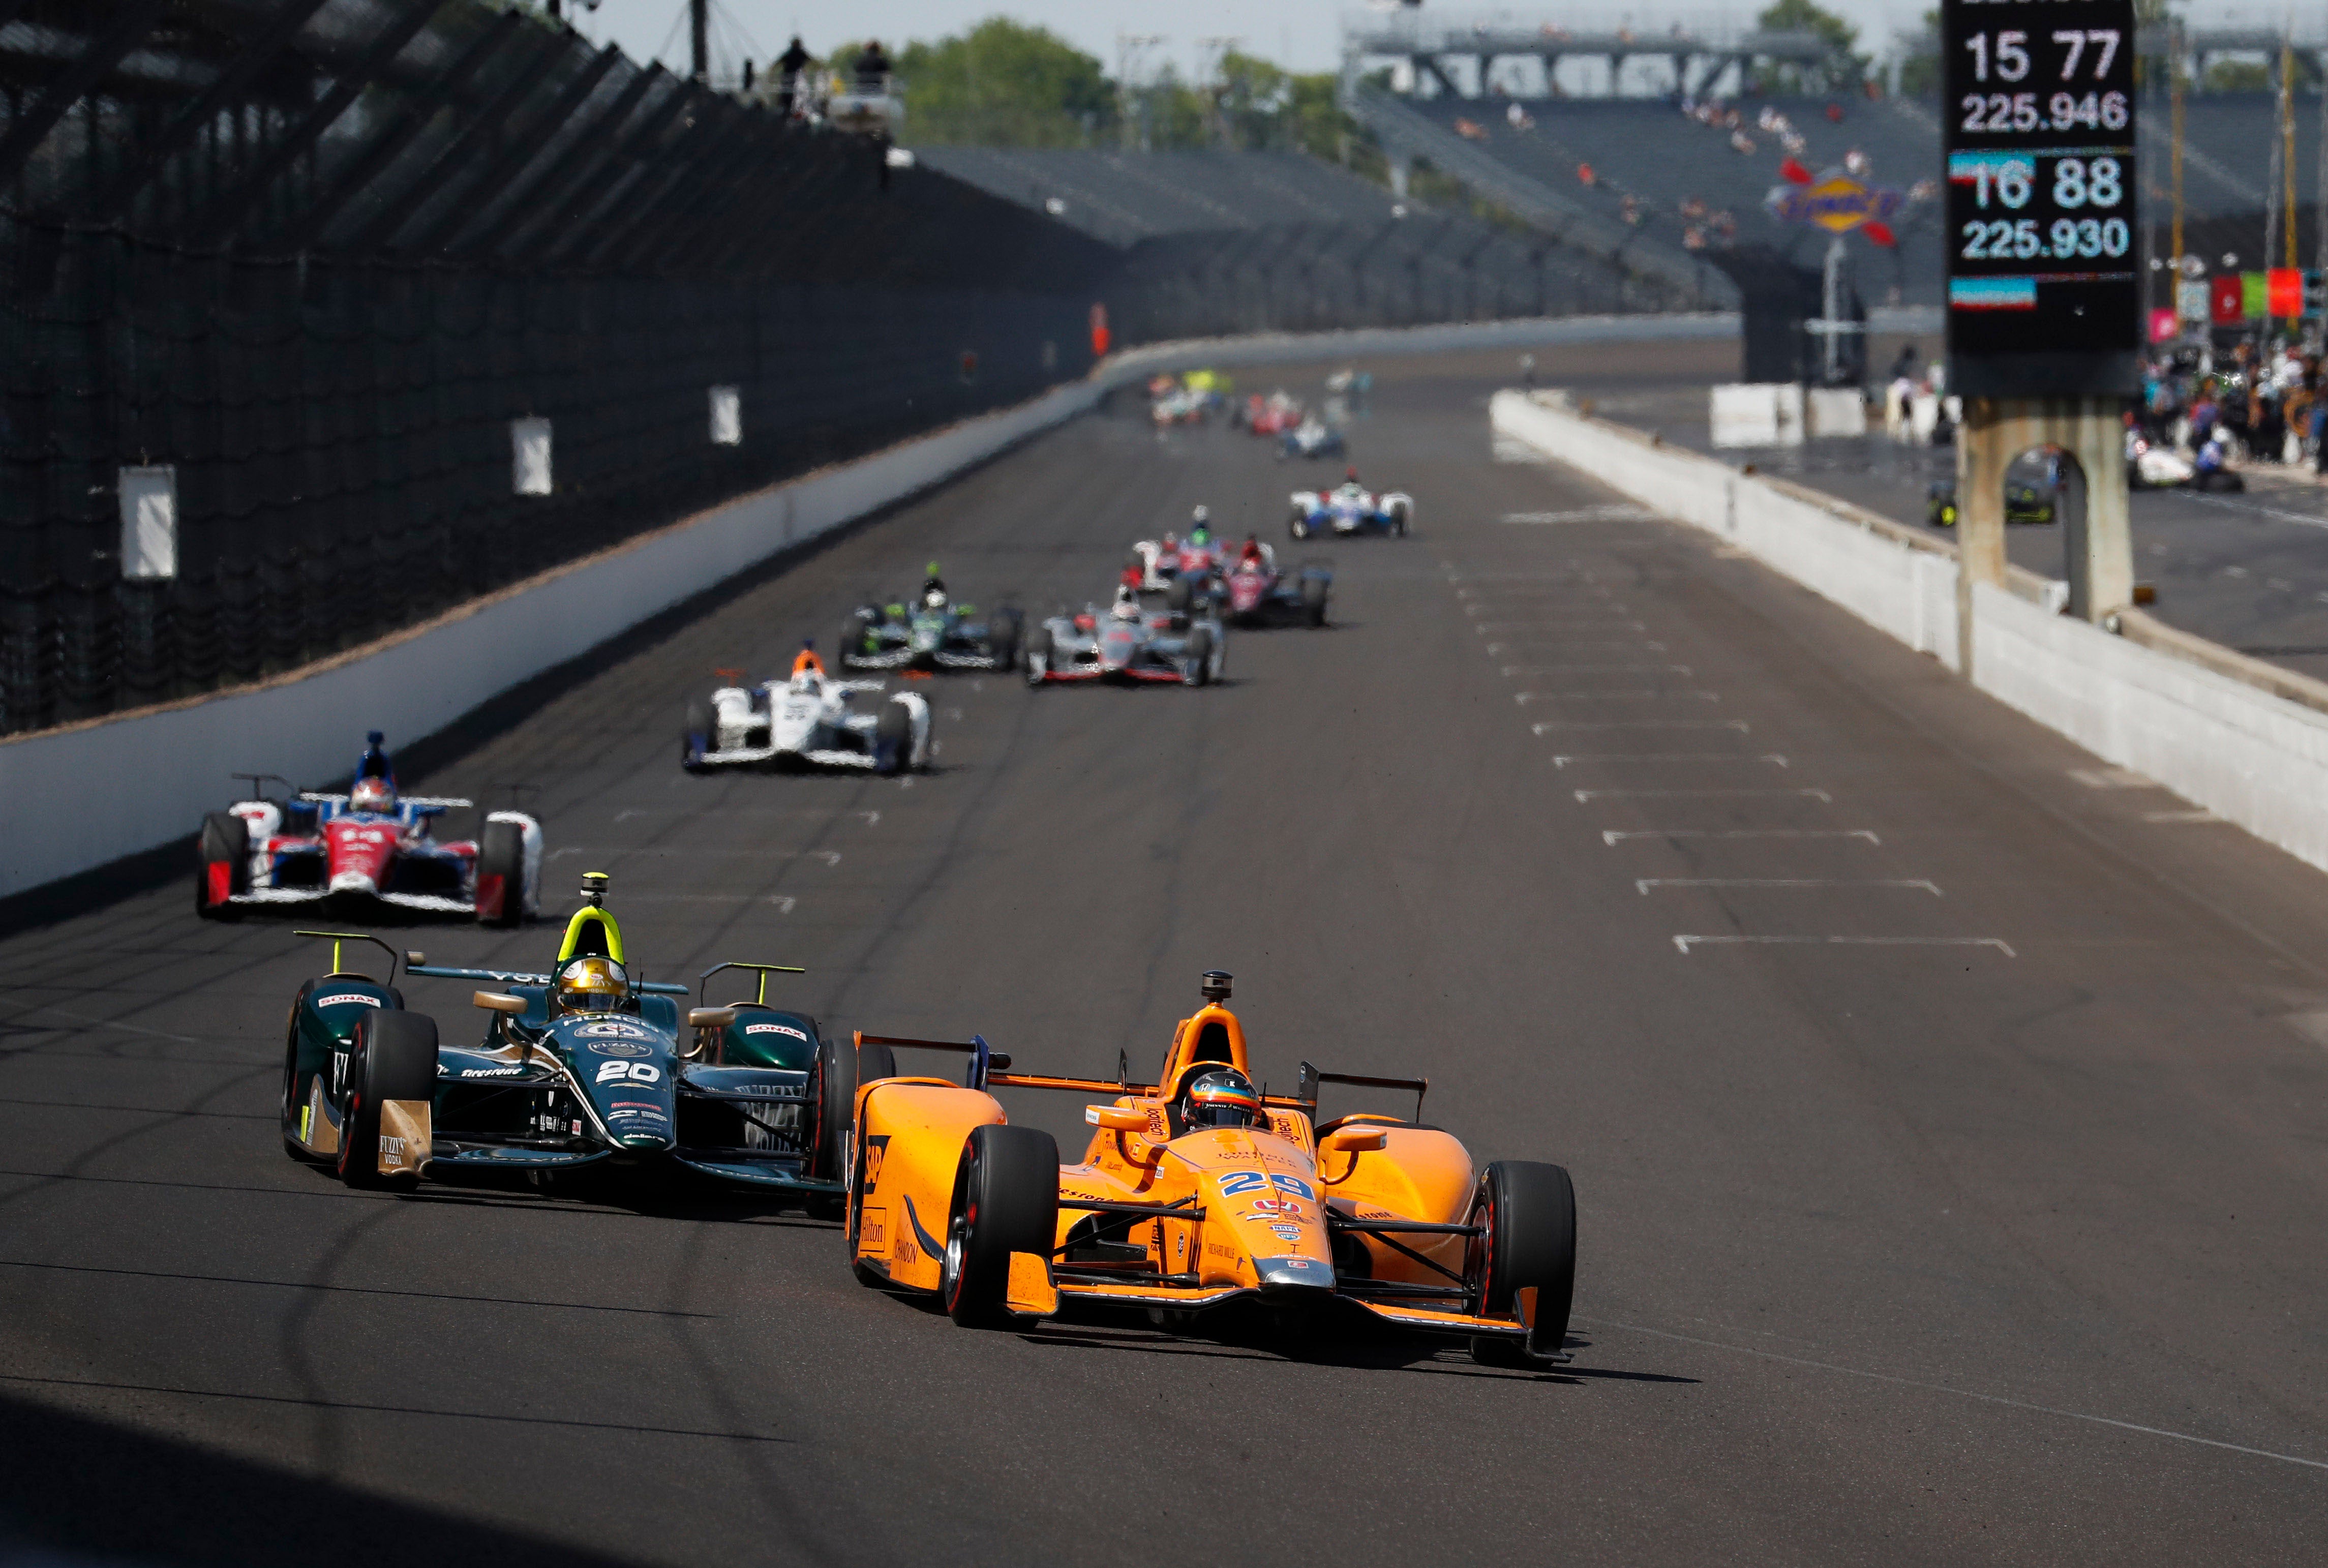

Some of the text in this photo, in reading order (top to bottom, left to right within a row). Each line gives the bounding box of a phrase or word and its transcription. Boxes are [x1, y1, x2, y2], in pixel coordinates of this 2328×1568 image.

[1965, 29, 2120, 82] 15 77
[1961, 91, 2128, 131] 225.946
[1969, 158, 2122, 208] 16 88
[1961, 219, 2129, 258] 225.930
[320, 994, 376, 1004] SONAX
[748, 1025, 802, 1038] SONAX
[595, 1061, 660, 1082] 20
[1278, 1116, 1301, 1145] gitech
[380, 1135, 406, 1155] FUZZY'S
[385, 1154, 402, 1165] VODKA
[866, 1145, 882, 1184] SAP
[1059, 1188, 1113, 1201] eston
[1218, 1171, 1317, 1202] 29
[1354, 1211, 1393, 1219] stone
[862, 1216, 883, 1242] Hilton
[895, 1239, 918, 1265] CHANDON
[1208, 1243, 1234, 1259] RICHARD MILLE
